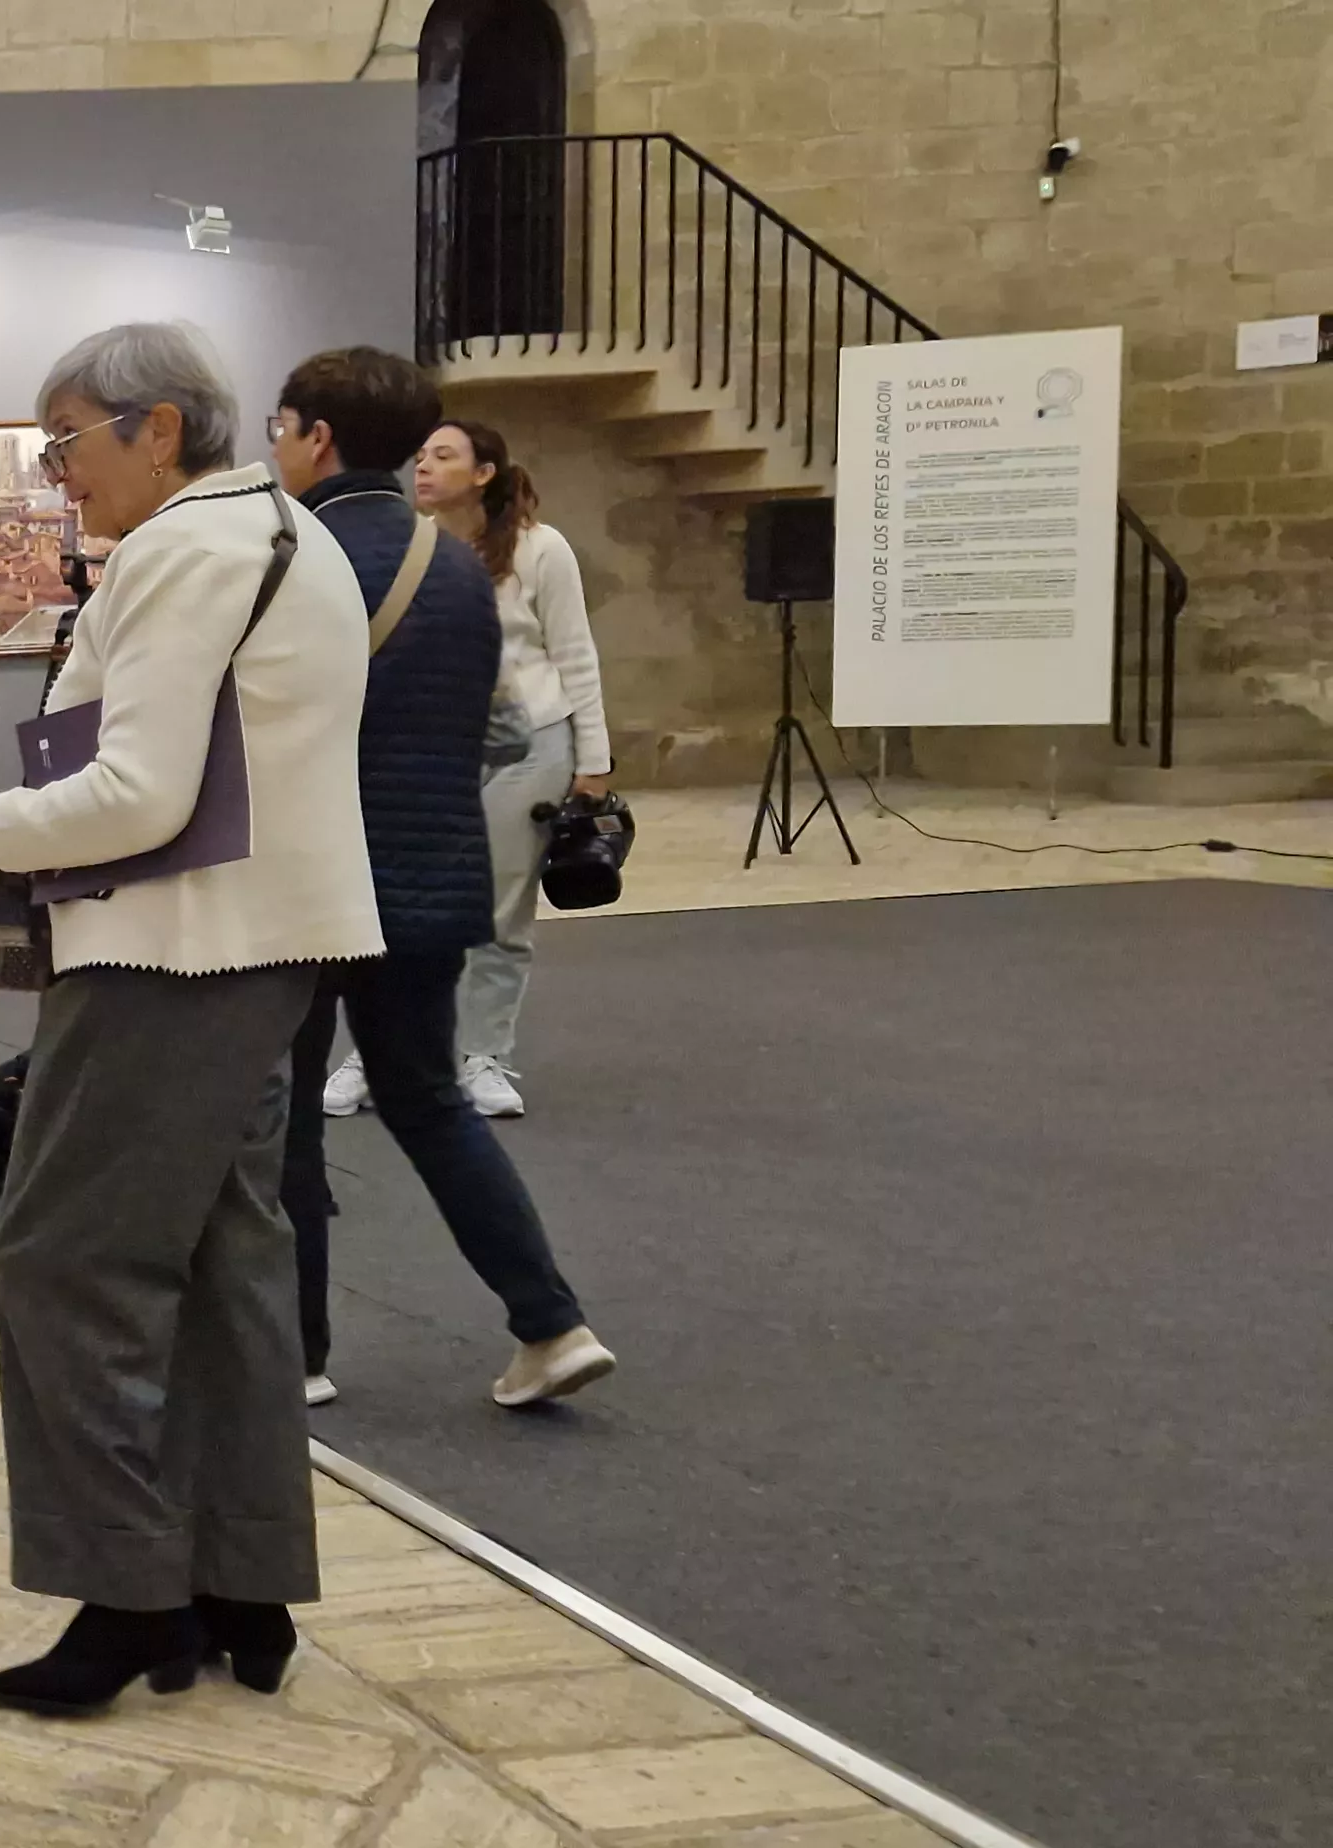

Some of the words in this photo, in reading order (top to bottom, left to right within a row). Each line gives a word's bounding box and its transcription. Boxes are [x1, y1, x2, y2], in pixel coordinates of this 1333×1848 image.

[907, 378, 946, 390] SALAS
[951, 376, 968, 388] DE
[906, 401, 922, 412] LA
[926, 396, 993, 410] CAMPANA
[997, 395, 1005, 405] Y
[925, 416, 1000, 431] PETRONILA
[875, 449, 890, 469] DE
[874, 474, 890, 520] REYES
[873, 525, 889, 551] LOS
[873, 556, 888, 576] DE
[871, 580, 887, 642] PALACIO
